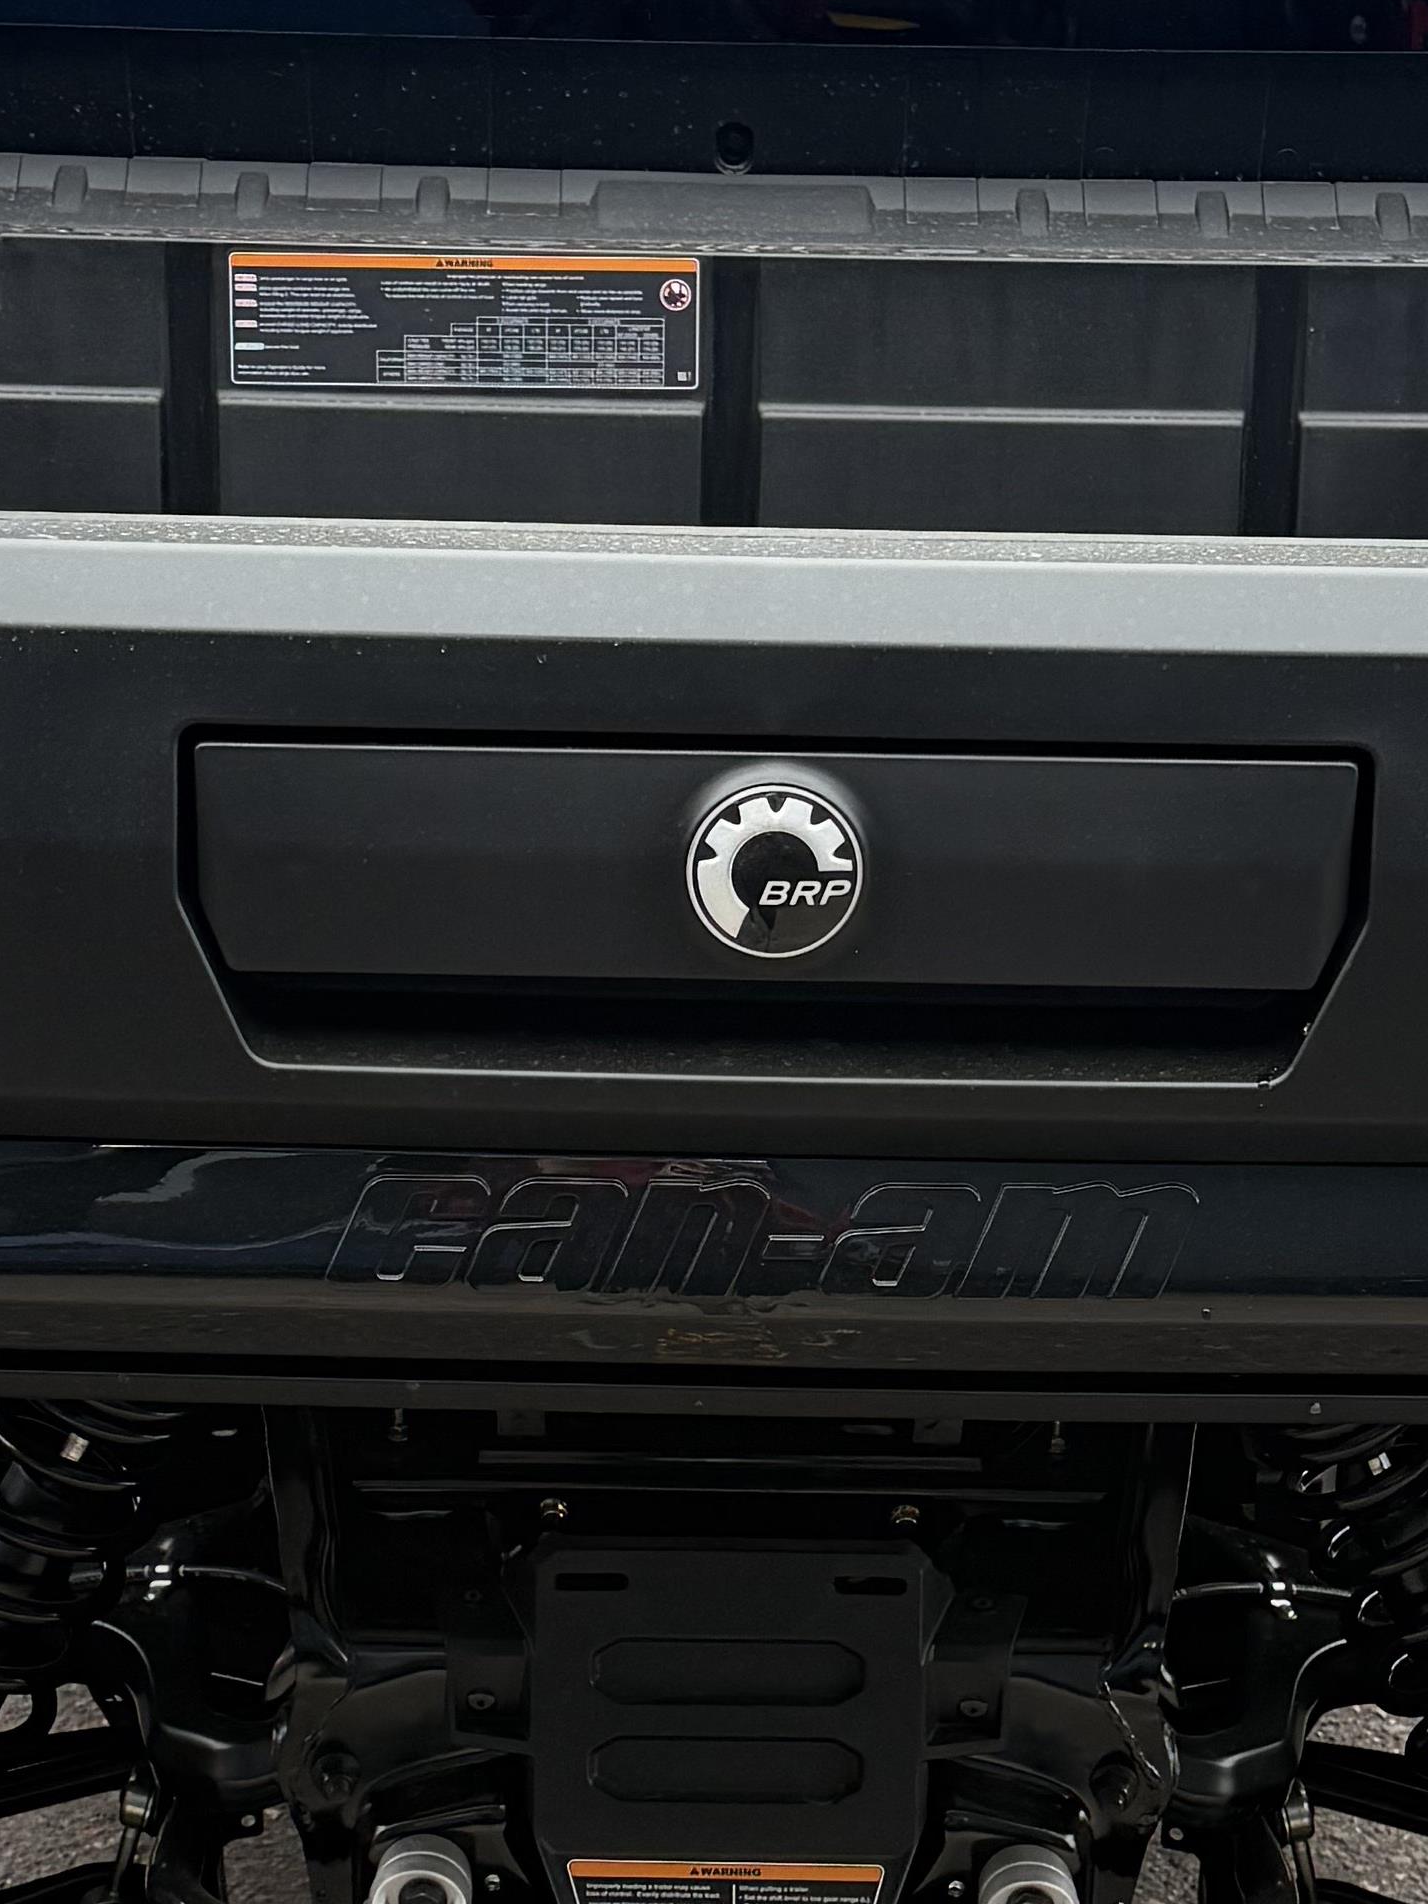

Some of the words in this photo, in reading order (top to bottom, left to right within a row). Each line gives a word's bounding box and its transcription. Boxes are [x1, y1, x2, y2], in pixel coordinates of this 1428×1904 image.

[759, 879, 852, 906] BRP
[325, 1174, 1200, 1300] can-am
[701, 1867, 761, 1876] WARNING
